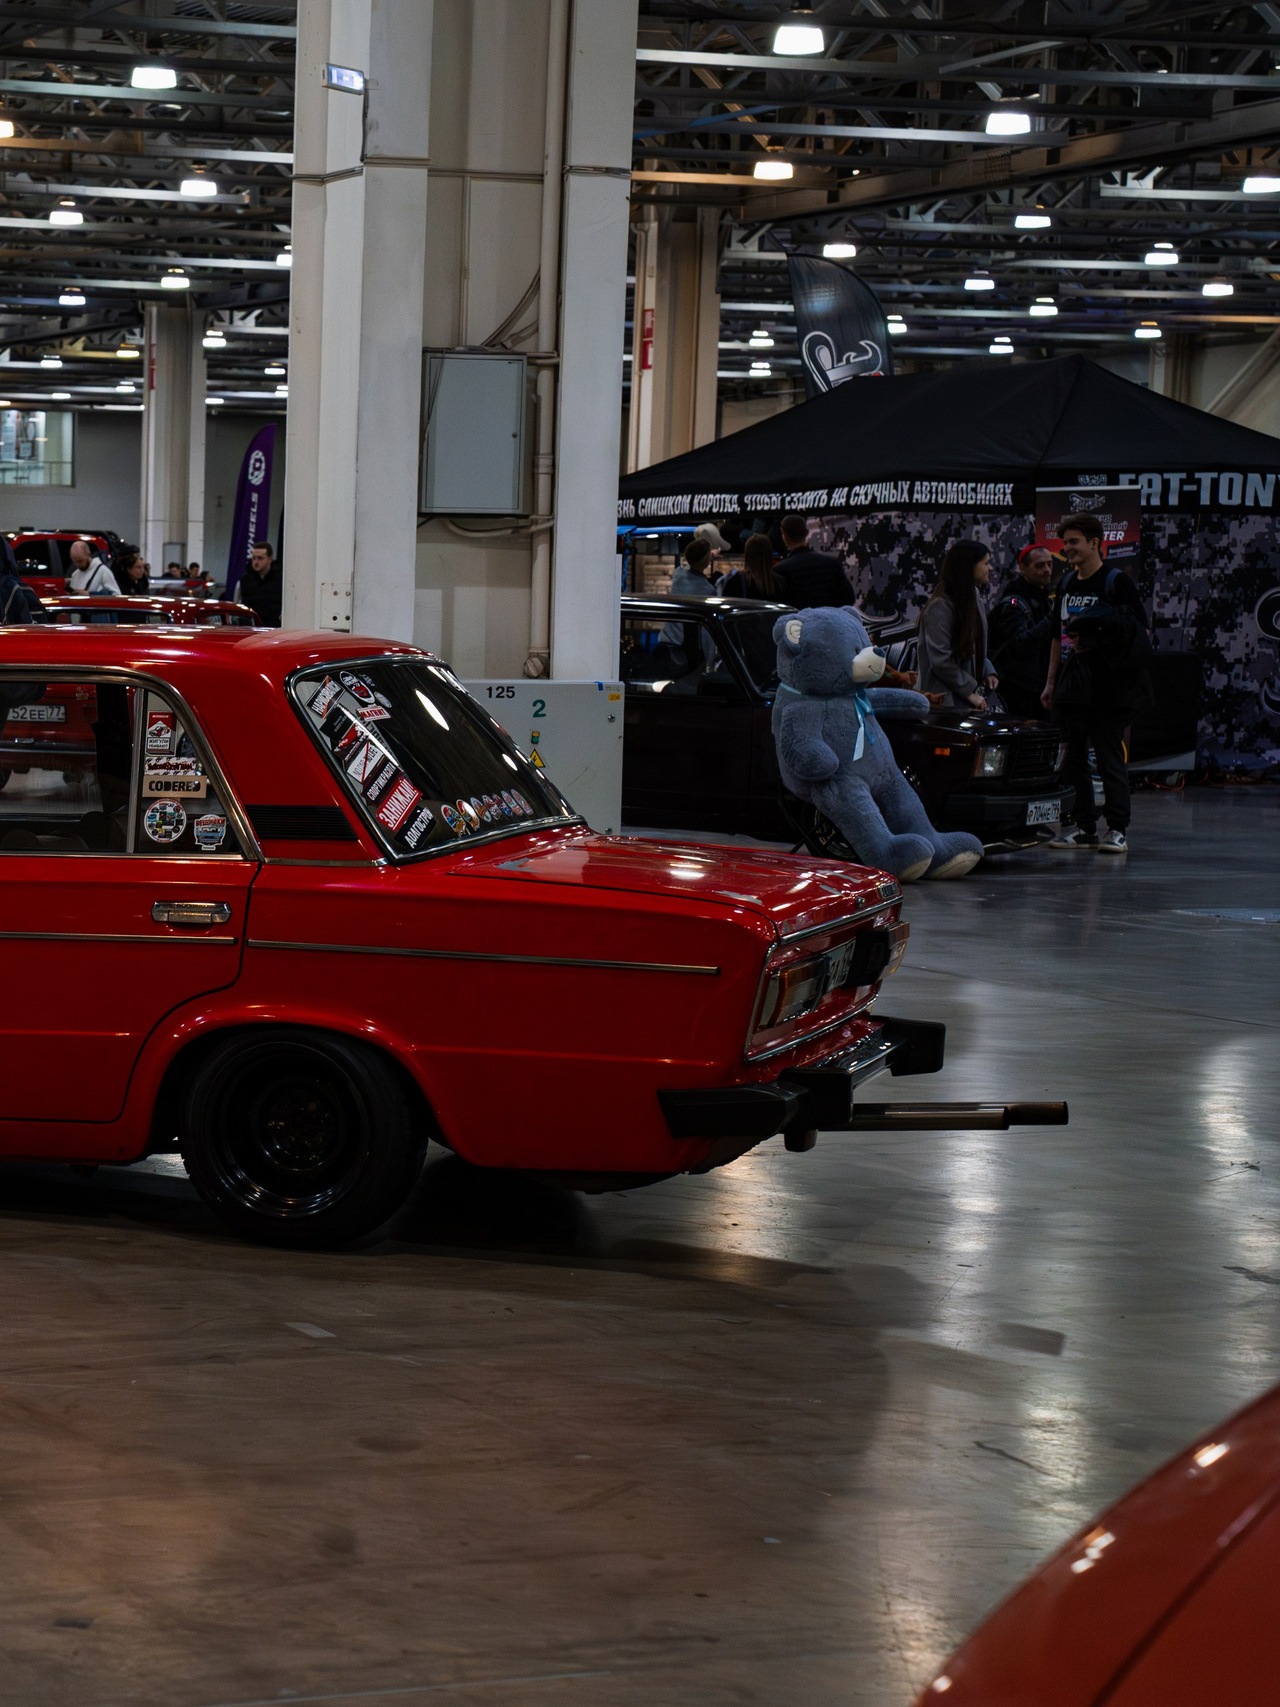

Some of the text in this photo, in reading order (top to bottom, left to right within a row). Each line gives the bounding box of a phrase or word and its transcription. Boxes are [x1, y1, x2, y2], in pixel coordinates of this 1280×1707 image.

[638, 494, 692, 516] СЛИШКОМ
[692, 494, 740, 514] КОРОТКА,
[744, 493, 781, 511] ЧТОБЫ
[784, 489, 828, 511] ЕЗДИТЬ
[830, 487, 849, 508] НА
[849, 480, 911, 507] СКУЧНЫХ
[912, 481, 1014, 506] АВТОМОБИЛЯХ
[1119, 472, 1280, 507] AT-TON
[246, 492, 259, 559] WHEELS
[487, 686, 515, 698] 125
[532, 699, 546, 718] 2
[148, 781, 201, 792] CODERED
[378, 778, 418, 828] ЗАНИЖАЙ!
